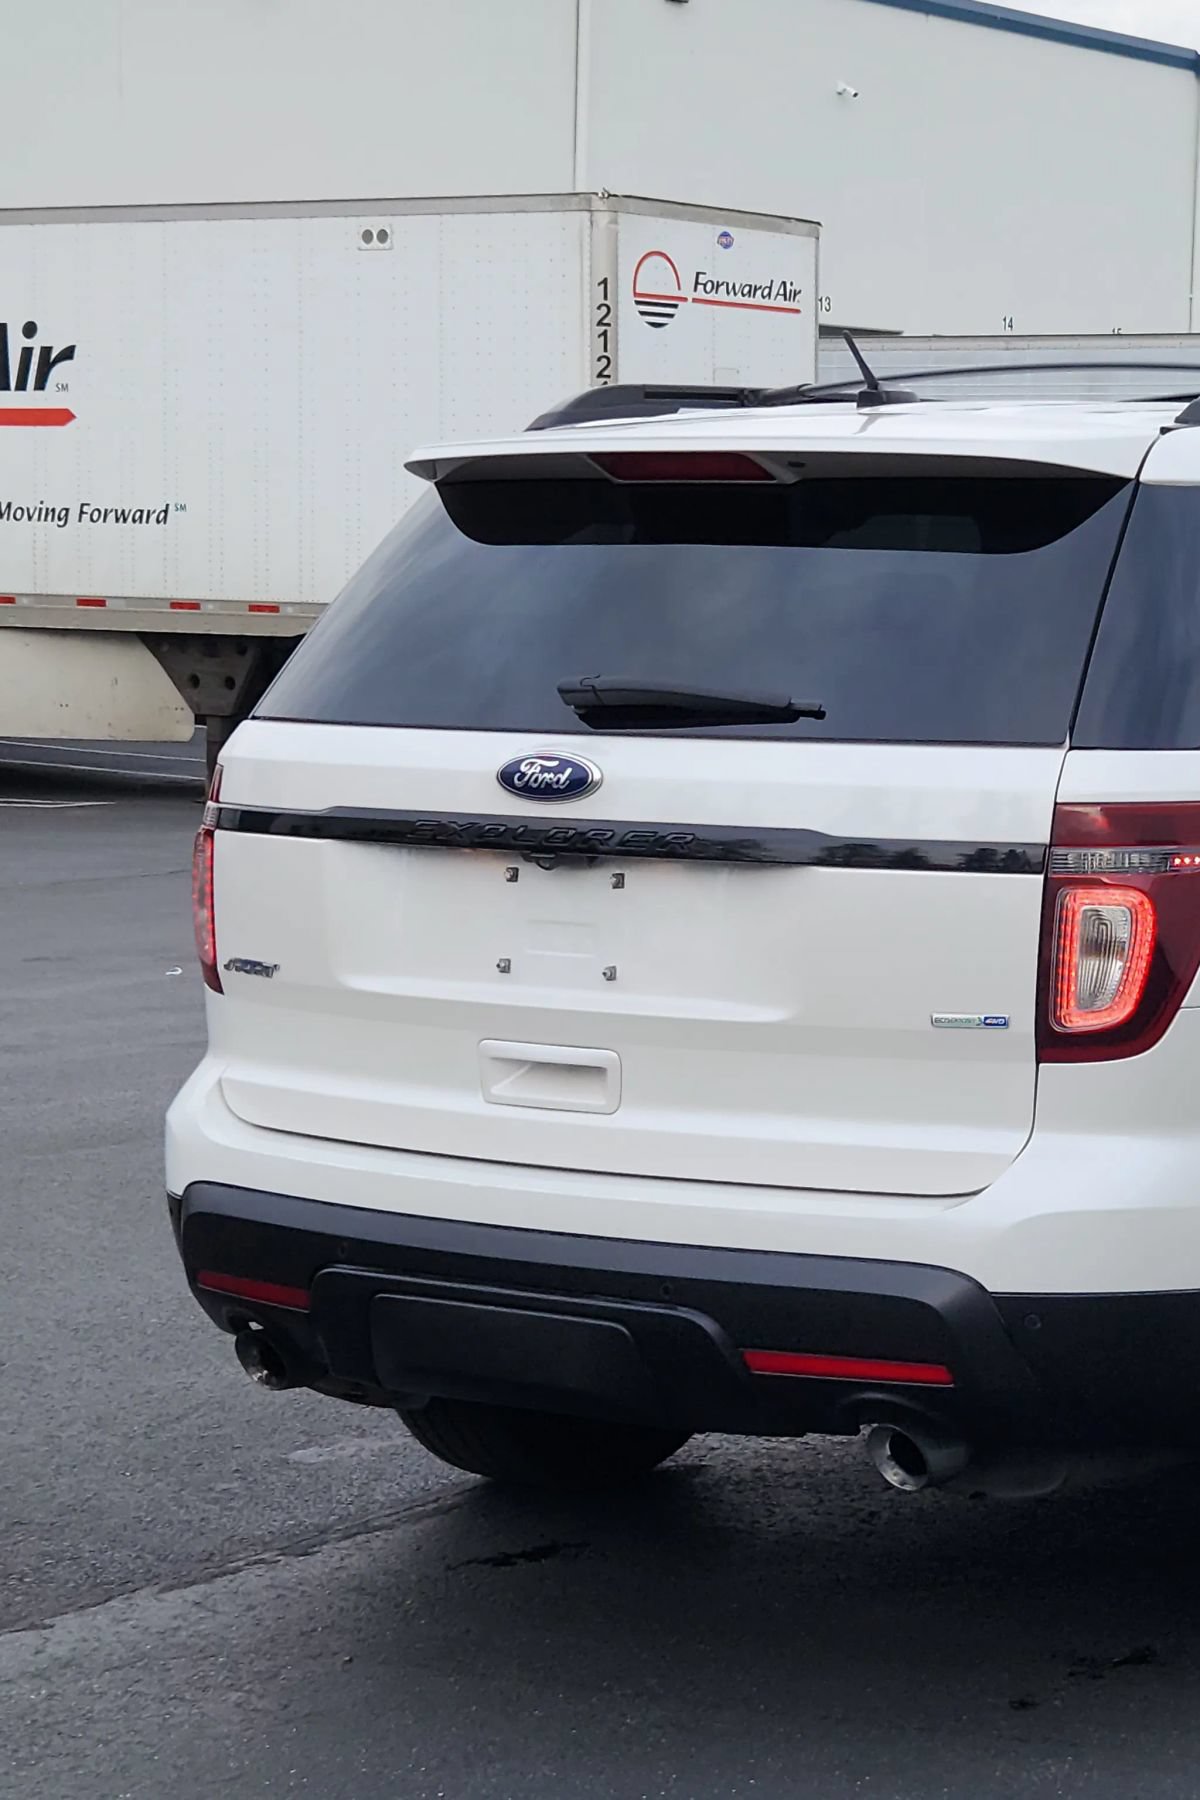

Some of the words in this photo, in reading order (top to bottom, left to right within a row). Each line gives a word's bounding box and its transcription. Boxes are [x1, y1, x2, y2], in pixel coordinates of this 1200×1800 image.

[694, 271, 774, 299] Forward
[774, 280, 802, 303] Air
[818, 296, 832, 312] 13
[596, 276, 612, 386] 1212
[1002, 315, 1014, 331] 14
[0, 320, 77, 391] ir
[0, 500, 70, 528] Moving
[77, 502, 170, 525] Forward
[513, 758, 574, 790] Ford
[406, 818, 697, 851] EXPLORER
